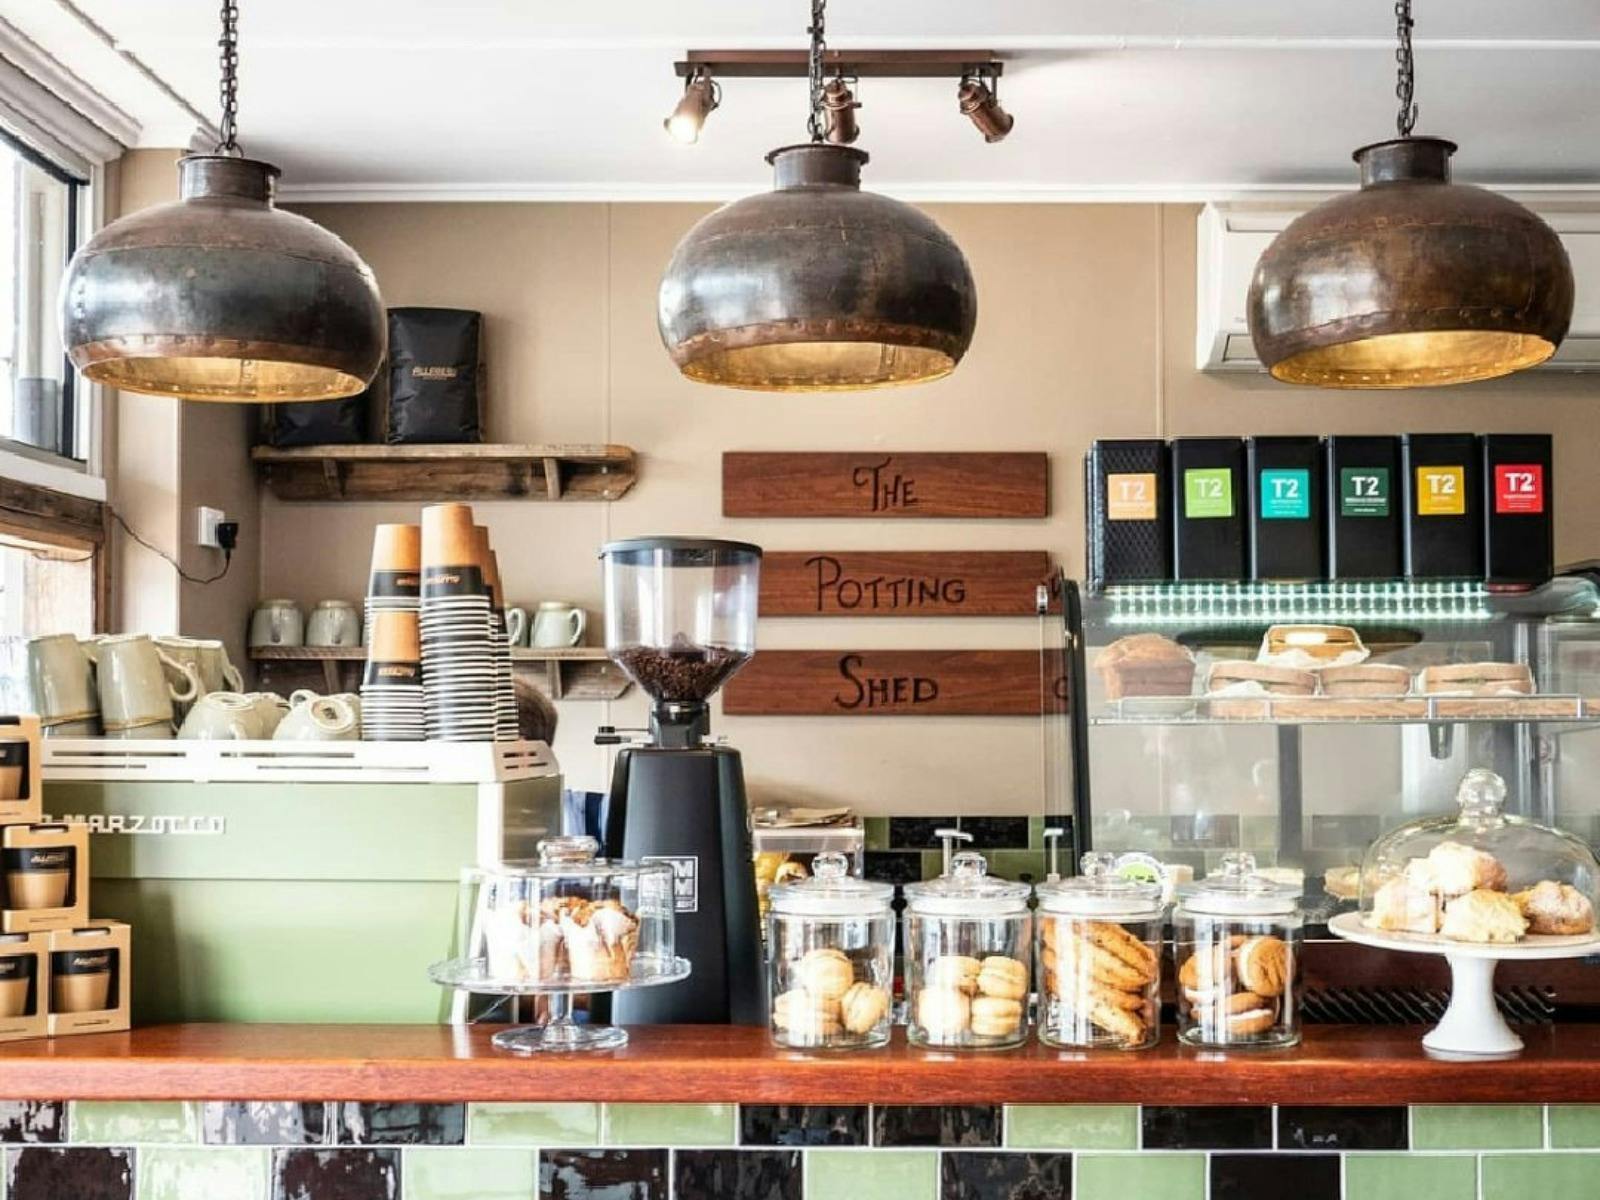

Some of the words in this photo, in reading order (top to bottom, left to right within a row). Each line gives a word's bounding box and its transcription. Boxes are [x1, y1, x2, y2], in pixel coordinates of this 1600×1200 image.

[853, 457, 918, 512] THE
[1119, 481, 1146, 500] T2
[1194, 478, 1223, 498] T2
[1271, 478, 1299, 498] T2
[1350, 476, 1380, 496] T2
[1425, 473, 1456, 494] T2
[1504, 472, 1534, 492] T2
[804, 556, 967, 612] POTTING
[833, 655, 939, 709] SHED
